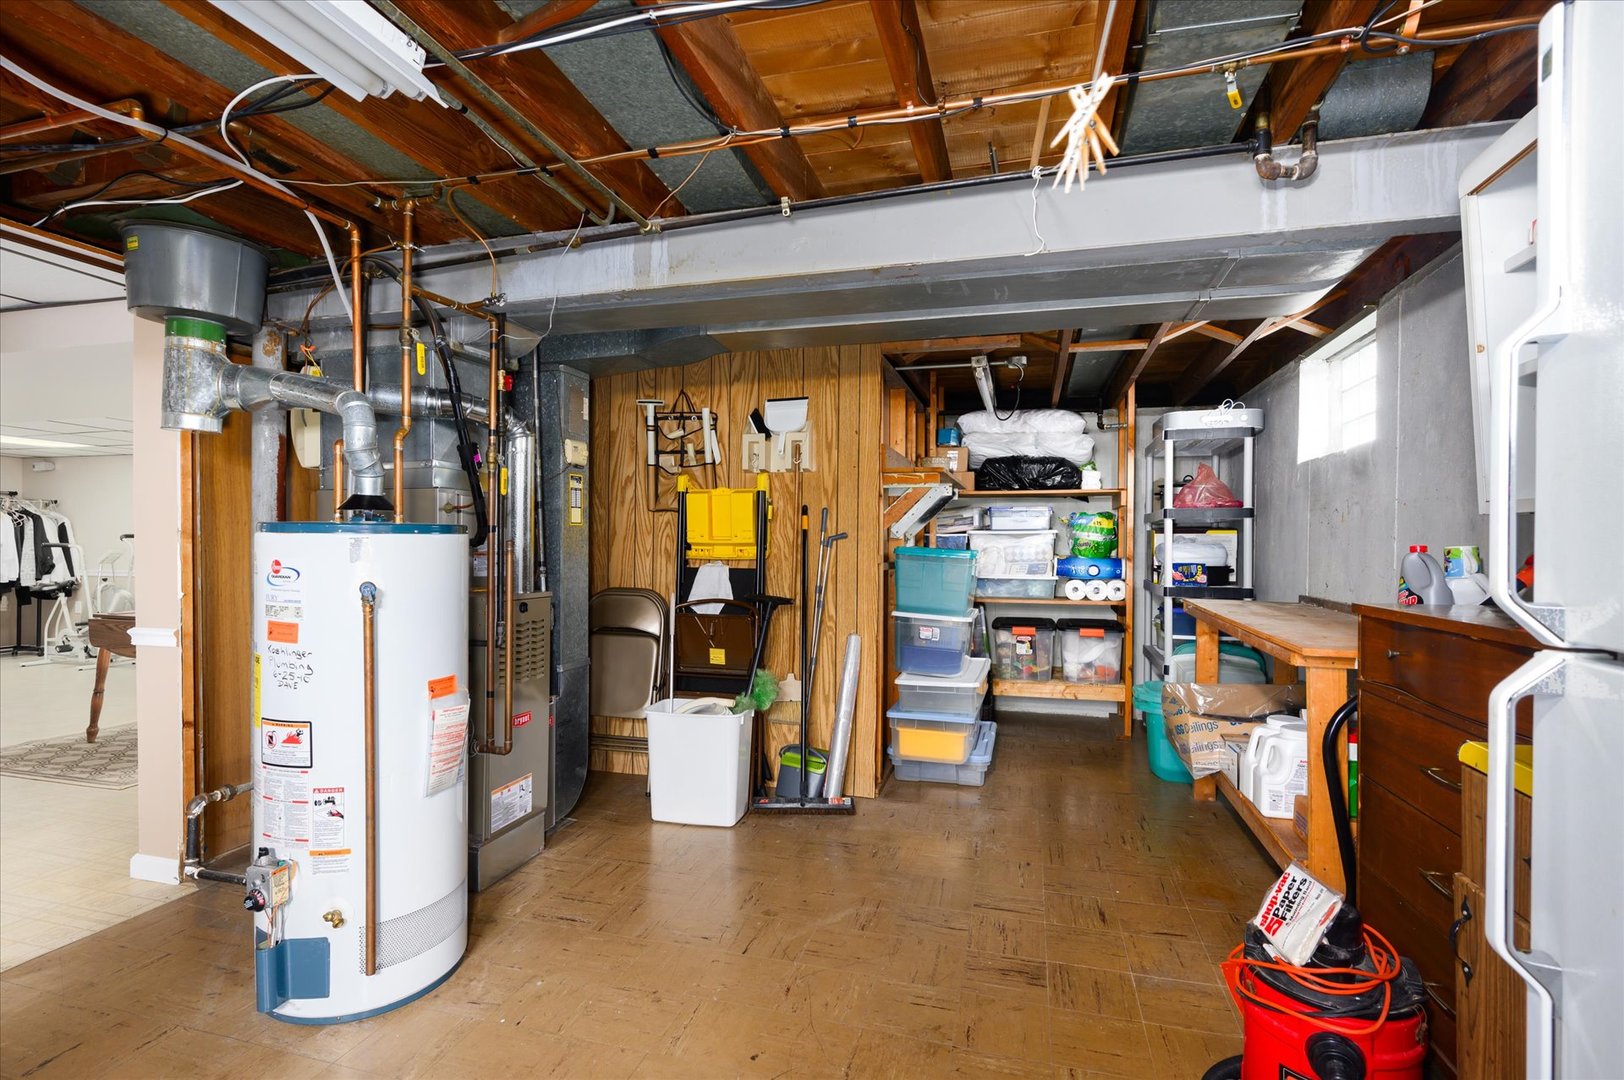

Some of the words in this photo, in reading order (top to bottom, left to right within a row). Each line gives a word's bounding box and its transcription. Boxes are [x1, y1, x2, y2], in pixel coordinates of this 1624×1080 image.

[268, 655, 314, 675] Plumbing
[514, 713, 529, 726] bryant
[1184, 720, 1219, 734] Ceilings
[1191, 740, 1220, 754] eilings
[1272, 875, 1298, 919] Paper
[1280, 877, 1307, 921] Filters
[1265, 918, 1284, 936] 5
